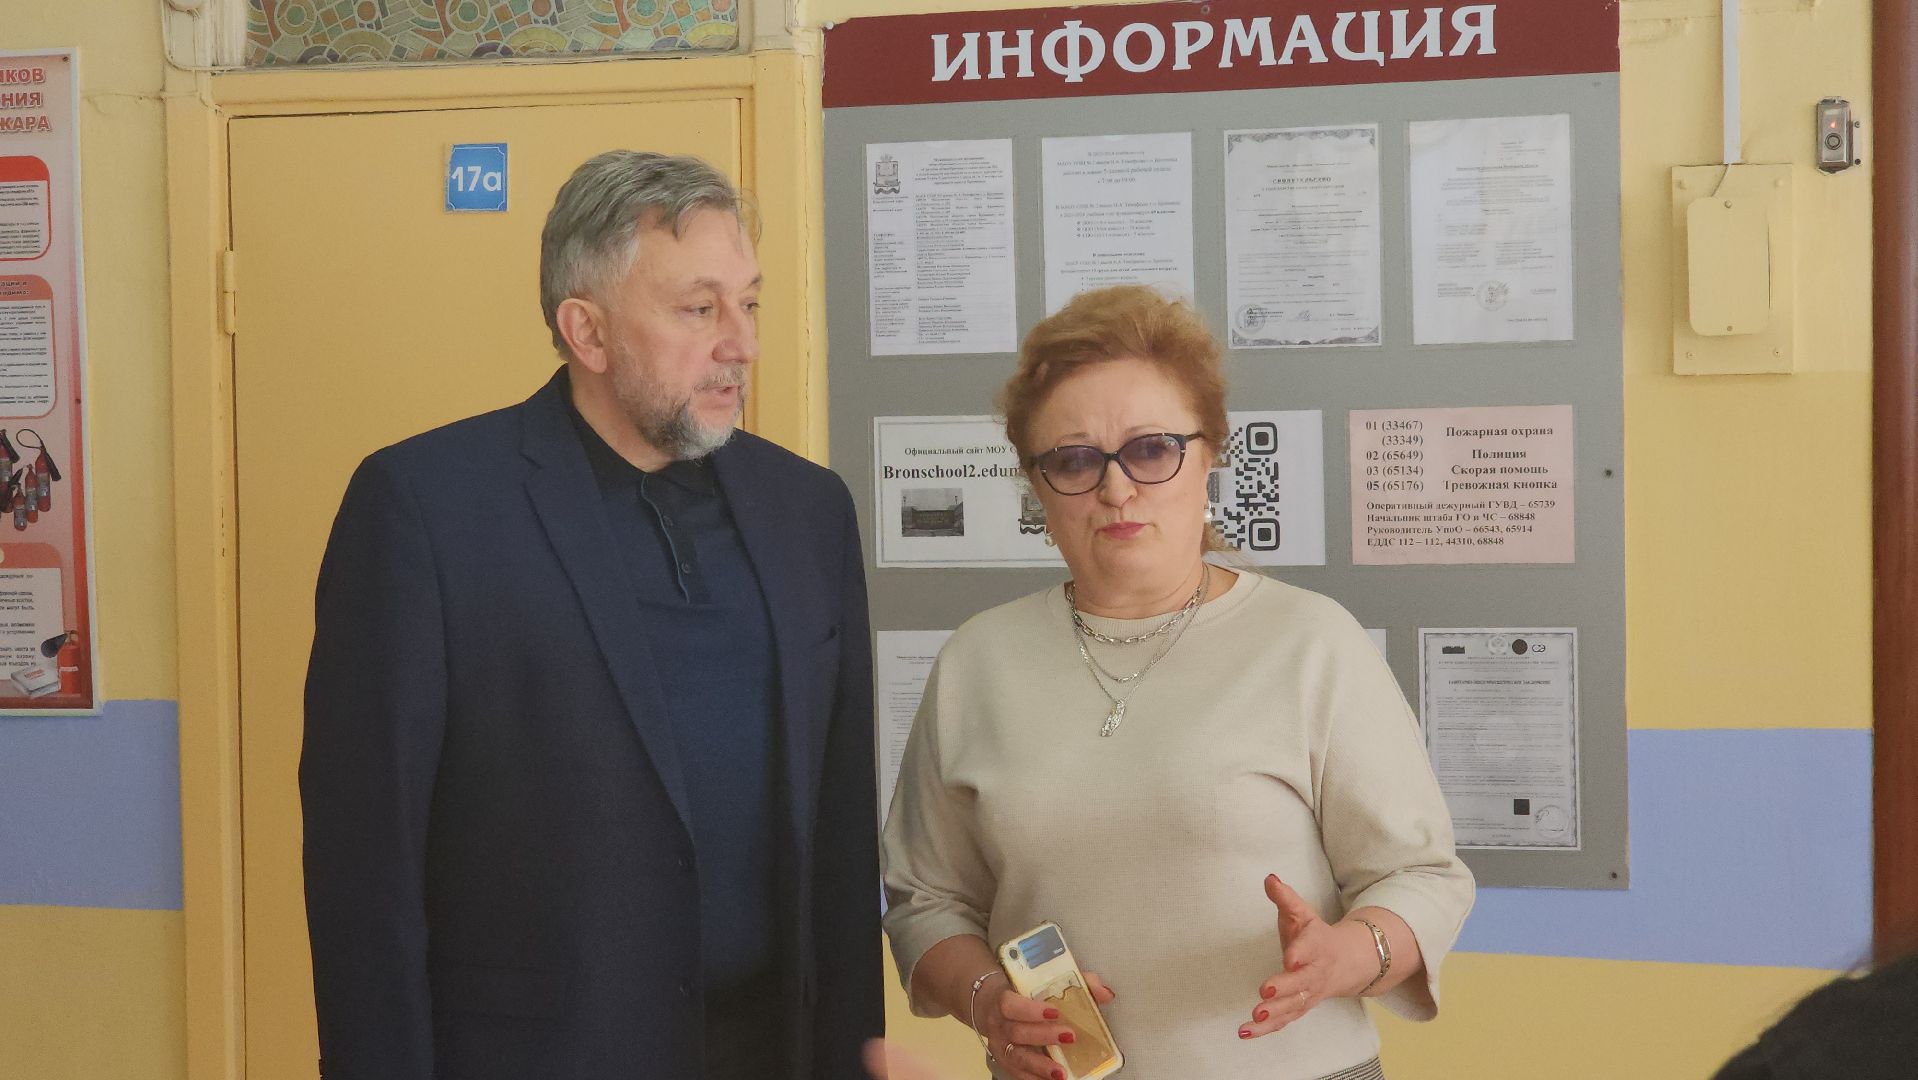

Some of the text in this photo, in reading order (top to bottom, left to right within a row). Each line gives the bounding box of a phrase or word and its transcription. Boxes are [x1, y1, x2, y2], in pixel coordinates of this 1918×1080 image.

[931, 4, 1497, 83] ИНФОРМАЦИЯ
[1365, 420, 1423, 432] 01 (33467)
[1446, 426, 1554, 439] Пожарная охрана
[1381, 434, 1424, 447] (33349)
[904, 446, 964, 457] Официальный
[966, 446, 984, 455] сайт
[985, 445, 1007, 454] МОУ
[1366, 450, 1424, 462] 02 (65649)
[1472, 449, 1527, 460] Полиция
[1366, 465, 1424, 478] 03 (65134)
[1450, 464, 1549, 477] Скорая помощь
[1366, 480, 1424, 492] 05 (65176)
[1443, 480, 1558, 493] Тревожная кнопка
[1366, 501, 1433, 512] Оперативный
[1436, 501, 1485, 512] дежурный
[1488, 500, 1519, 510] ГУВД
[1528, 500, 1556, 509] 65739
[1367, 514, 1420, 522] Начальник
[1423, 513, 1453, 522] штаба
[1456, 513, 1471, 521] ГО
[1482, 512, 1498, 521] ЧС
[1508, 512, 1536, 521] 68848
[1367, 526, 1433, 536] Руководитель
[1367, 538, 1396, 547] ЕДДС
[1399, 538, 1414, 546] 112
[1477, 537, 1505, 545] 68848
